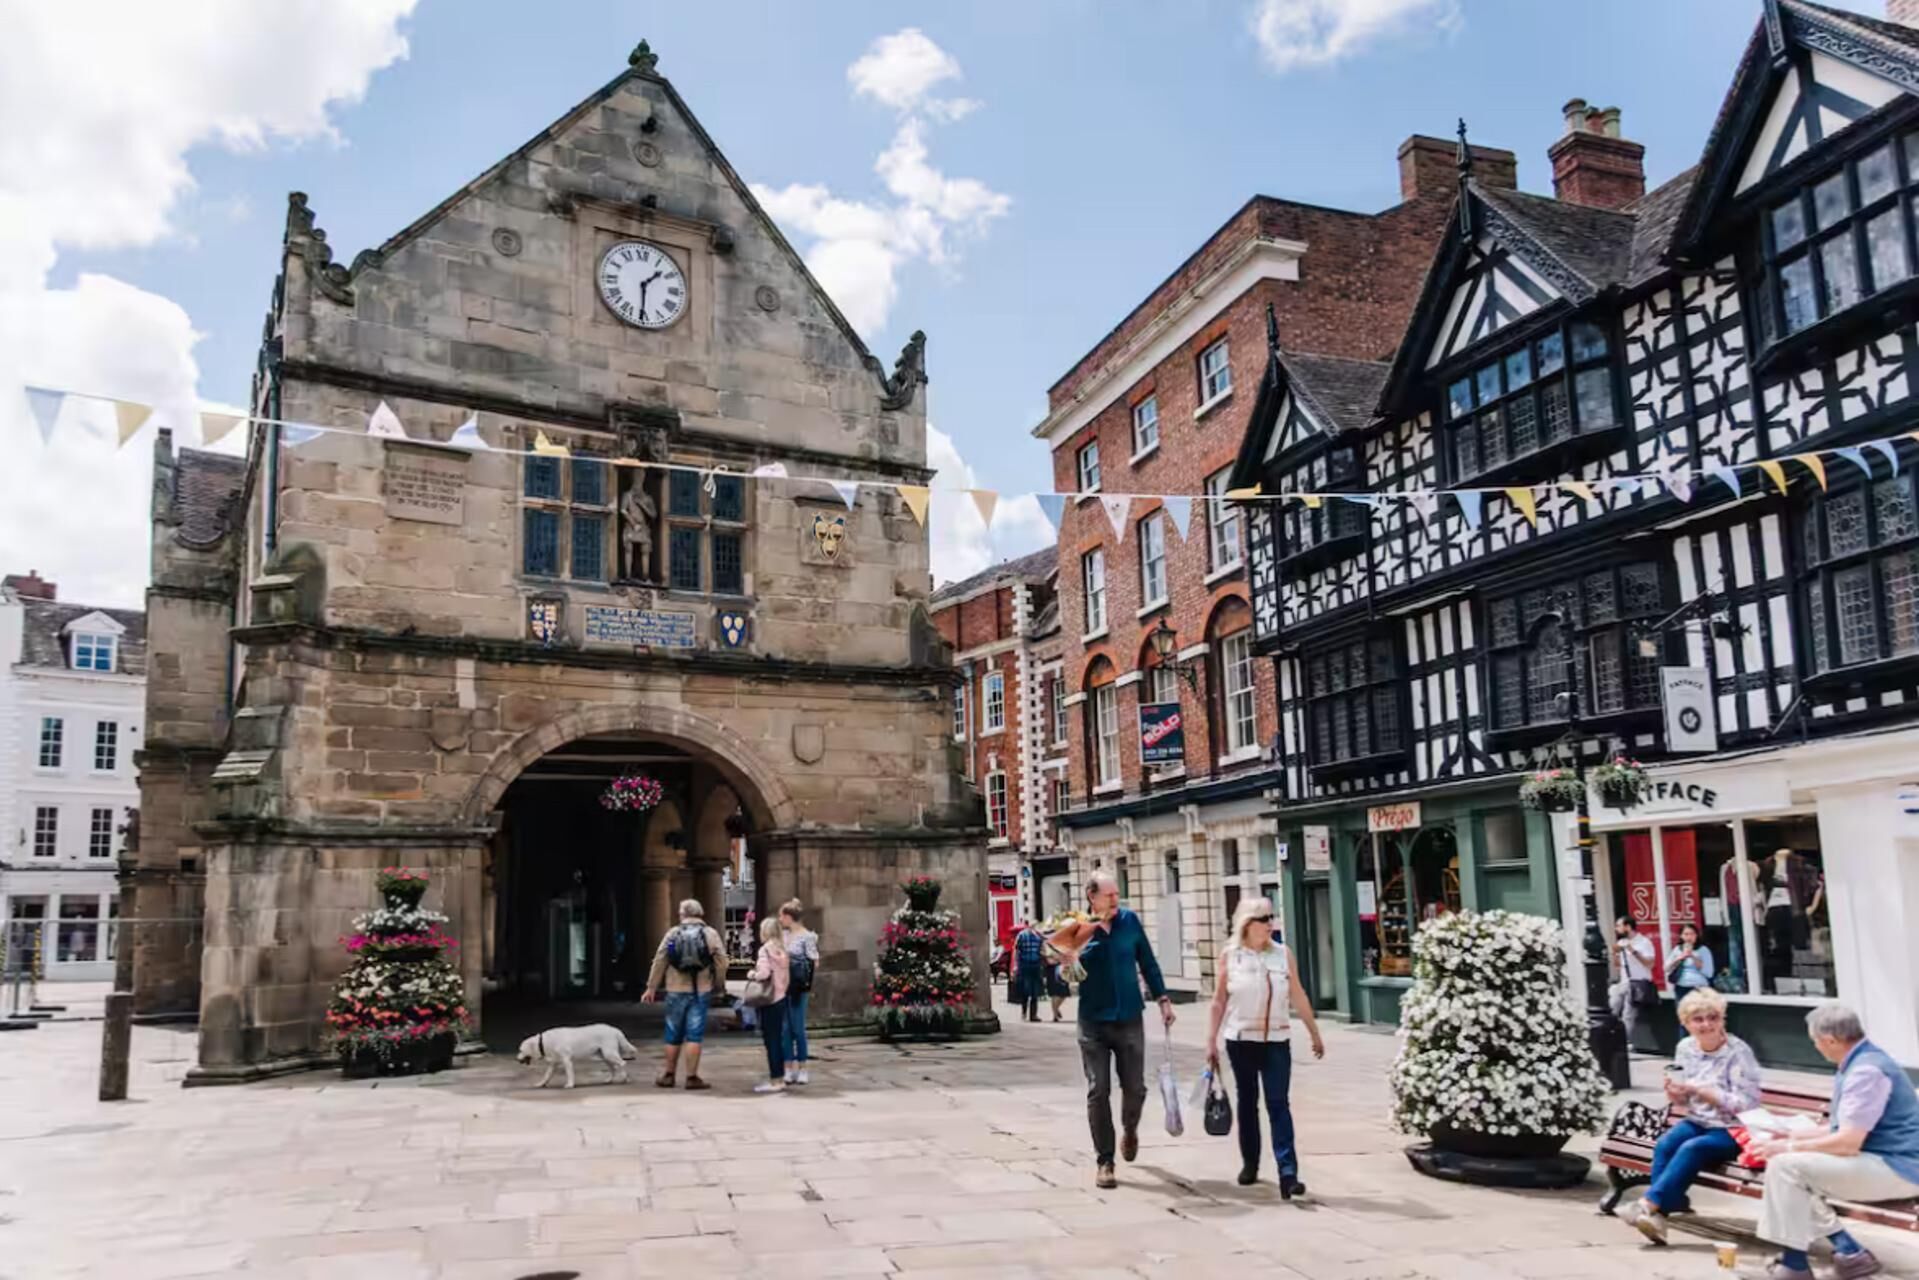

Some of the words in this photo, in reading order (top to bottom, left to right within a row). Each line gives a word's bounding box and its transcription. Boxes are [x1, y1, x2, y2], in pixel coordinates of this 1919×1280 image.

[1143, 713, 1180, 744] SOLD
[1619, 781, 1717, 816] TFACE
[1372, 806, 1414, 832] Prego
